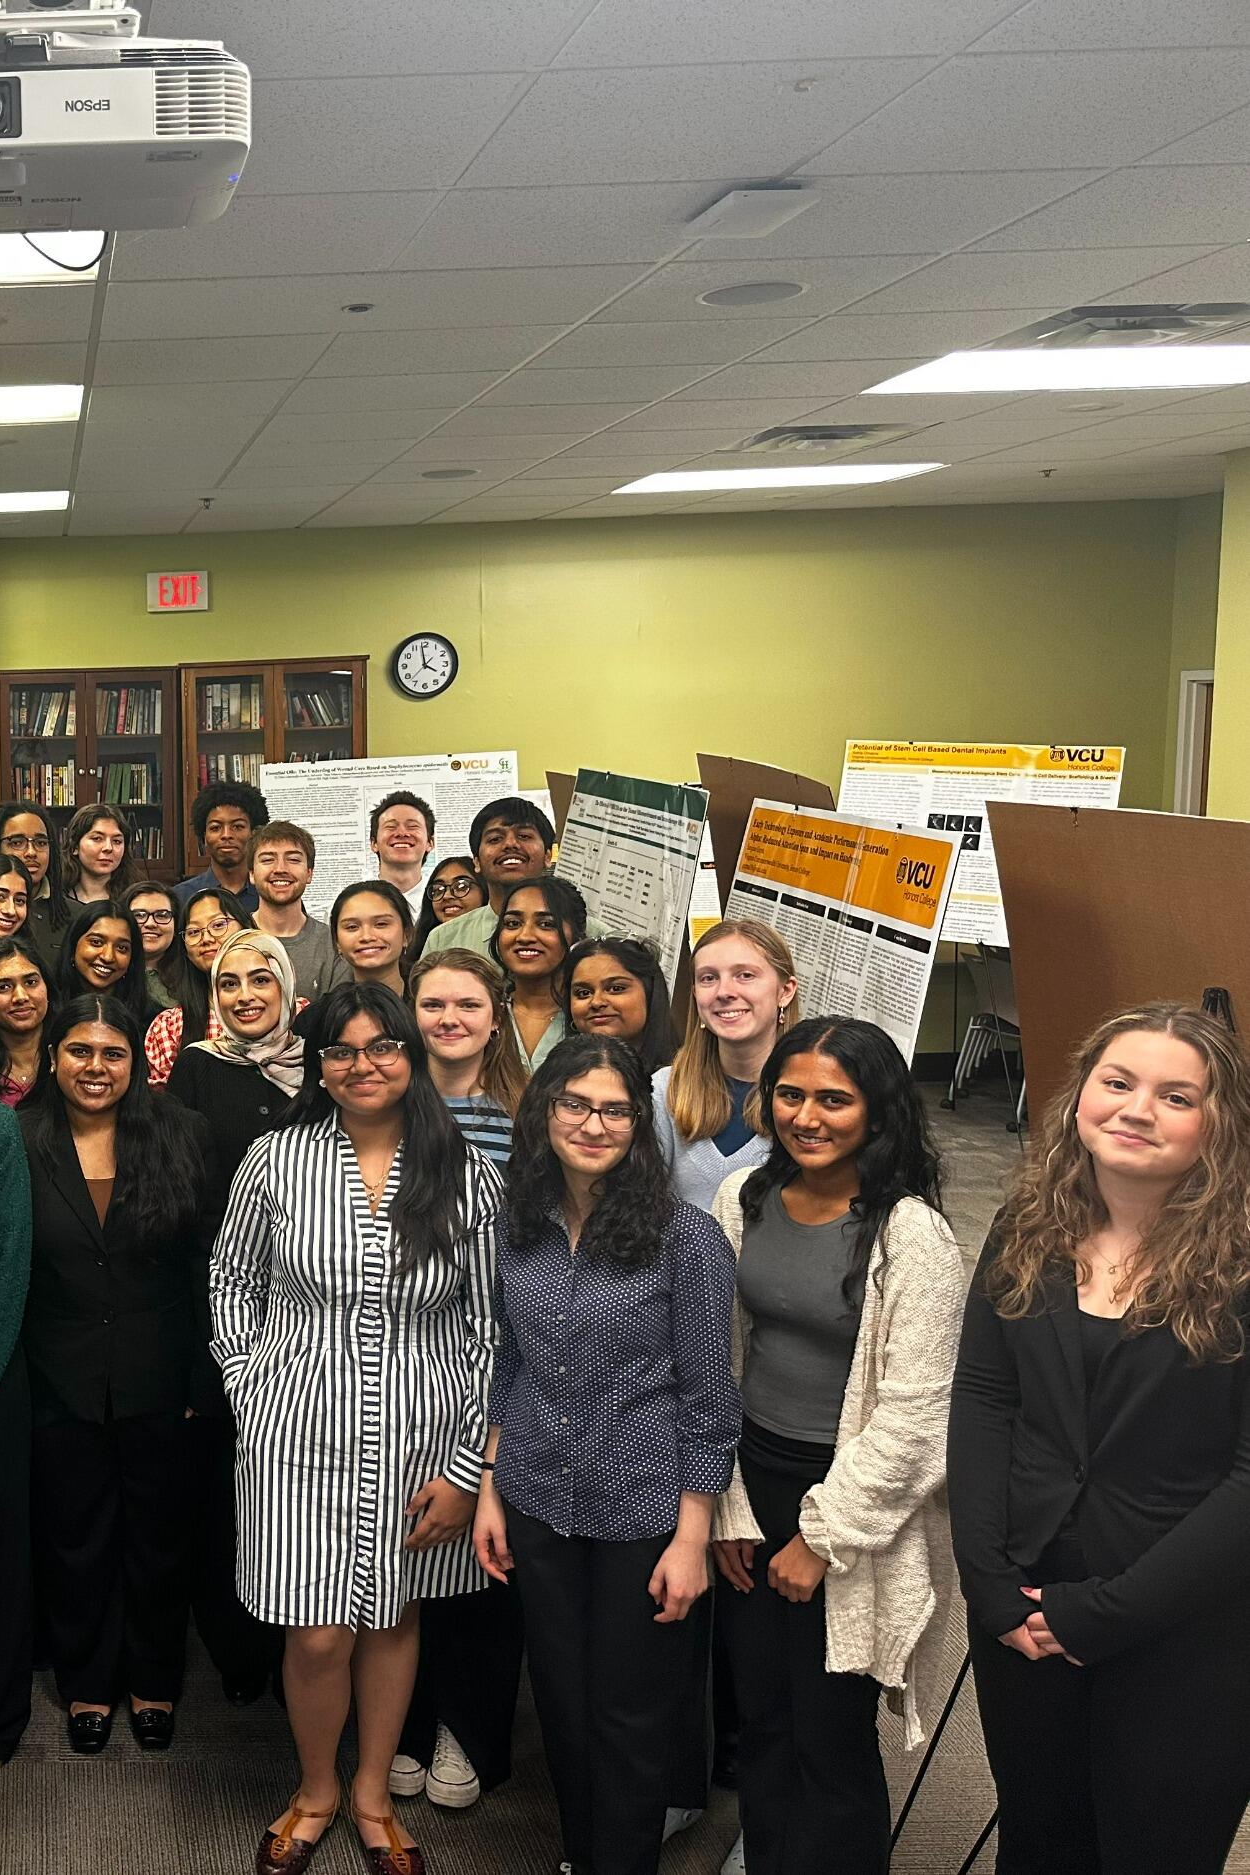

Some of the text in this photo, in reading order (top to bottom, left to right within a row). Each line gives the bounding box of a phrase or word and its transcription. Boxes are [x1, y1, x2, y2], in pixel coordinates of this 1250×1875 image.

[65, 100, 110, 112] EPSON
[158, 576, 199, 607] EXIT
[976, 747, 1006, 755] Implants
[1067, 749, 1104, 762] VCU
[463, 760, 488, 769] VCU
[907, 860, 935, 889] VCU
